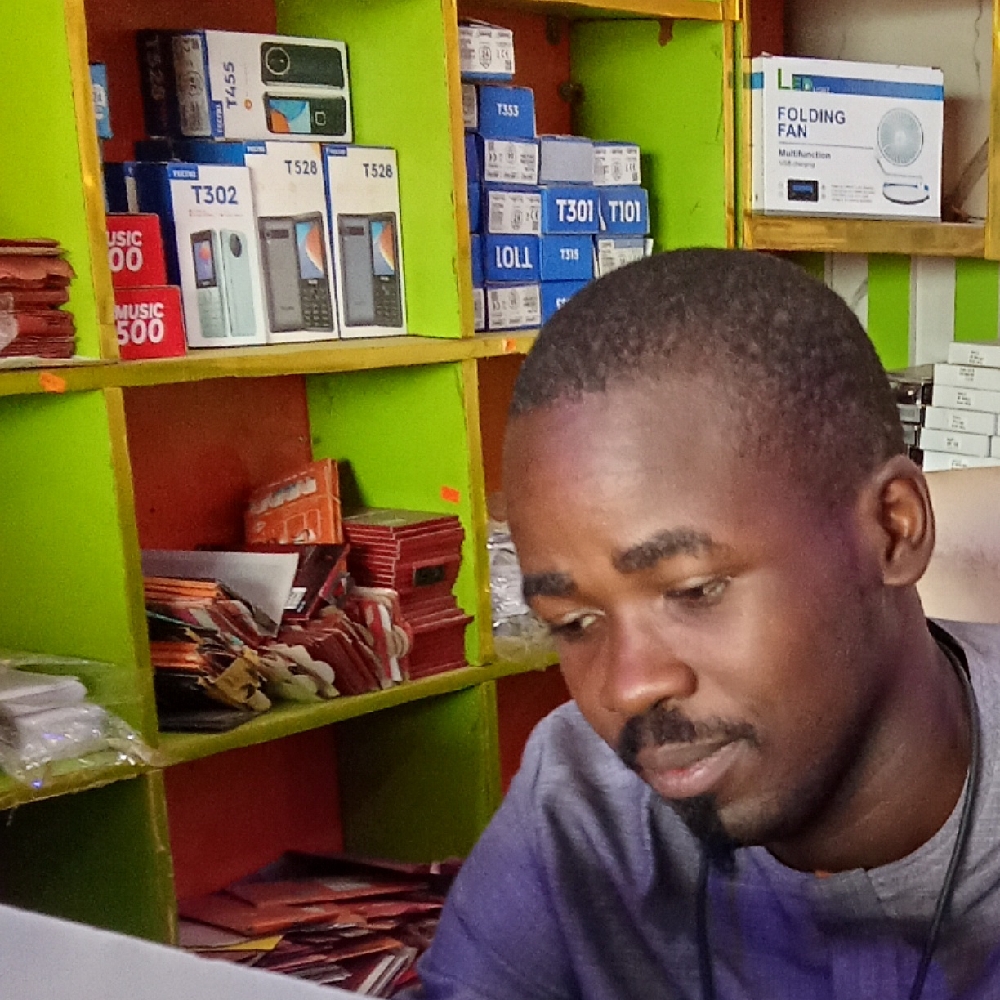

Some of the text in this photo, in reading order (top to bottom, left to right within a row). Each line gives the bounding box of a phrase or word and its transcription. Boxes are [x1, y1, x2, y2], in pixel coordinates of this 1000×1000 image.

[224, 60, 240, 110] T455
[777, 105, 846, 125] FOLDING
[777, 122, 808, 138] FAN
[284, 159, 318, 175] T528
[363, 162, 393, 179] T528
[190, 184, 240, 206] T302
[555, 198, 594, 222] T301
[608, 200, 642, 222] T101
[107, 230, 143, 248] USIC
[108, 247, 144, 272] 00
[495, 245, 533, 269] T101
[114, 301, 164, 319] MUSIC
[117, 318, 164, 345] 500
